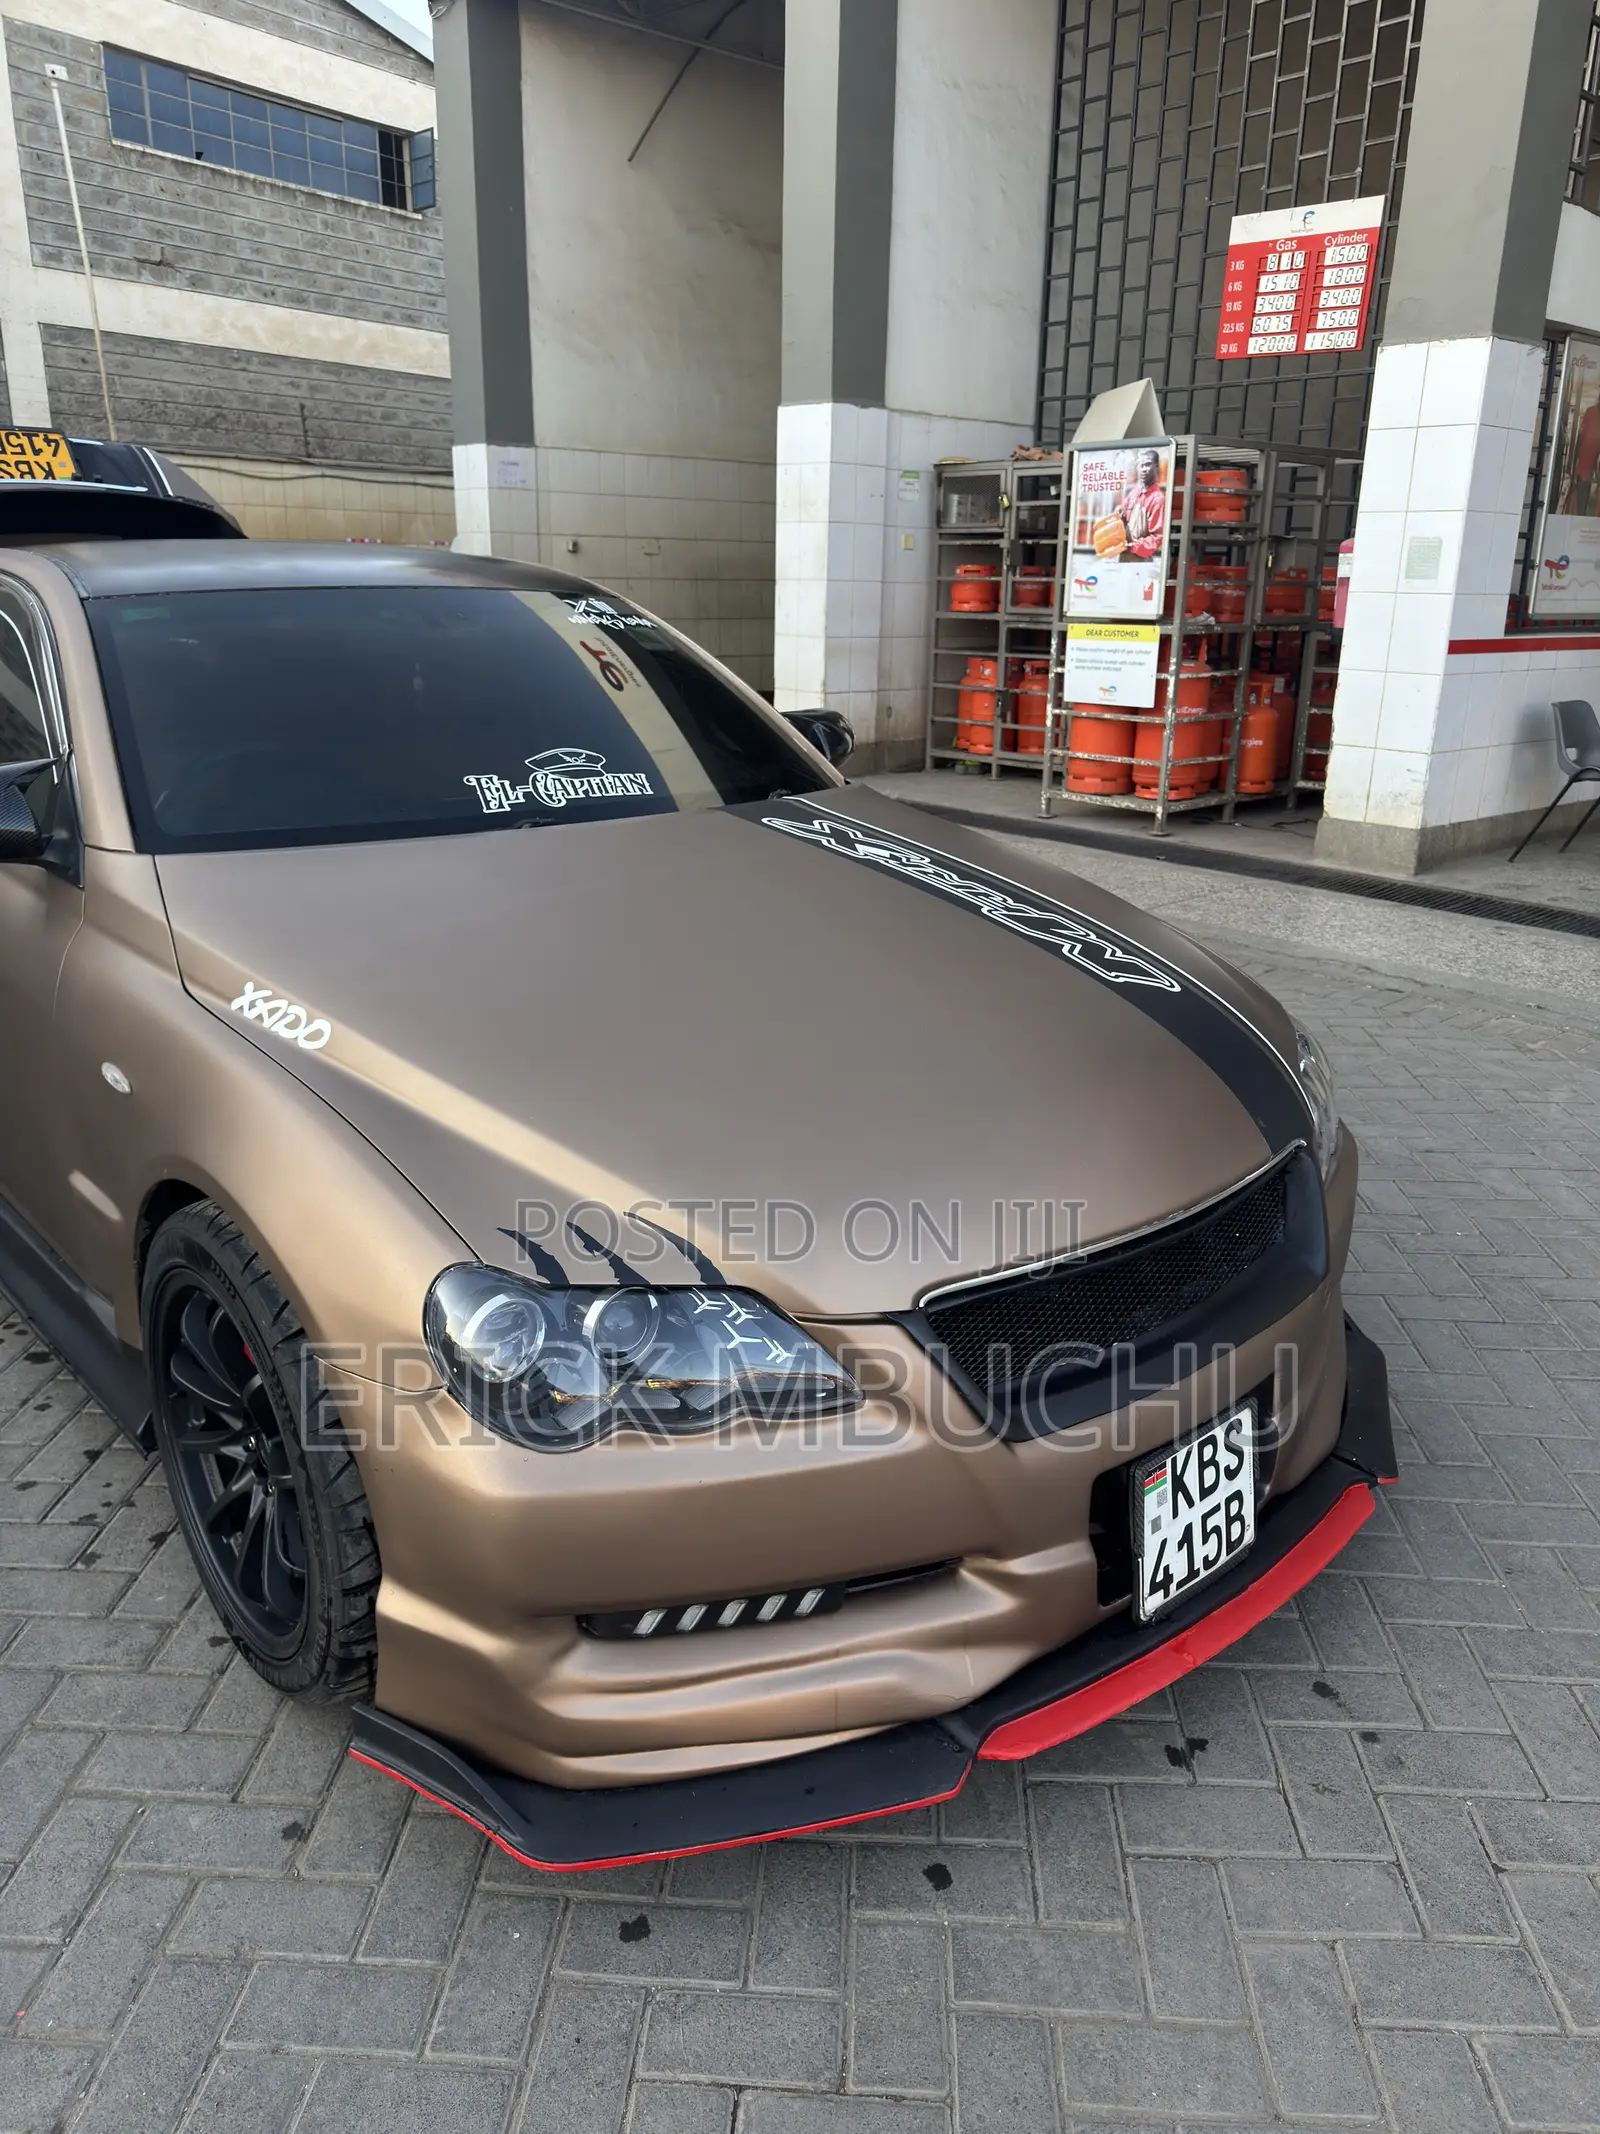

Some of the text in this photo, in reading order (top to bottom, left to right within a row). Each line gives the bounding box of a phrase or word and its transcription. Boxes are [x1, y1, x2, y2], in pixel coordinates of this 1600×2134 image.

[1276, 232, 1368, 251] Gas Cylinder
[1330, 244, 1367, 263] 1500
[1230, 261, 1235, 271] 3
[1236, 260, 1245, 271] KG
[1328, 266, 1365, 285] 1800
[1228, 282, 1233, 292] 6
[1233, 281, 1243, 291] KG
[1233, 301, 1242, 311] KG
[1257, 294, 1295, 313] 3400
[1320, 288, 1361, 307] 3400
[1235, 322, 1245, 332] KG
[1321, 309, 1358, 327] 7500
[1229, 343, 1238, 353] KG
[1253, 335, 1296, 352] 12000
[1311, 331, 1356, 349] 11500
[1083, 462, 1108, 472] SAFE.
[1083, 471, 1128, 482] RELIABLE.
[1086, 629, 1139, 638] DEAR CUSTOMER
[1171, 1417, 1245, 1520] KBS
[1149, 1488, 1246, 1600] 415B
